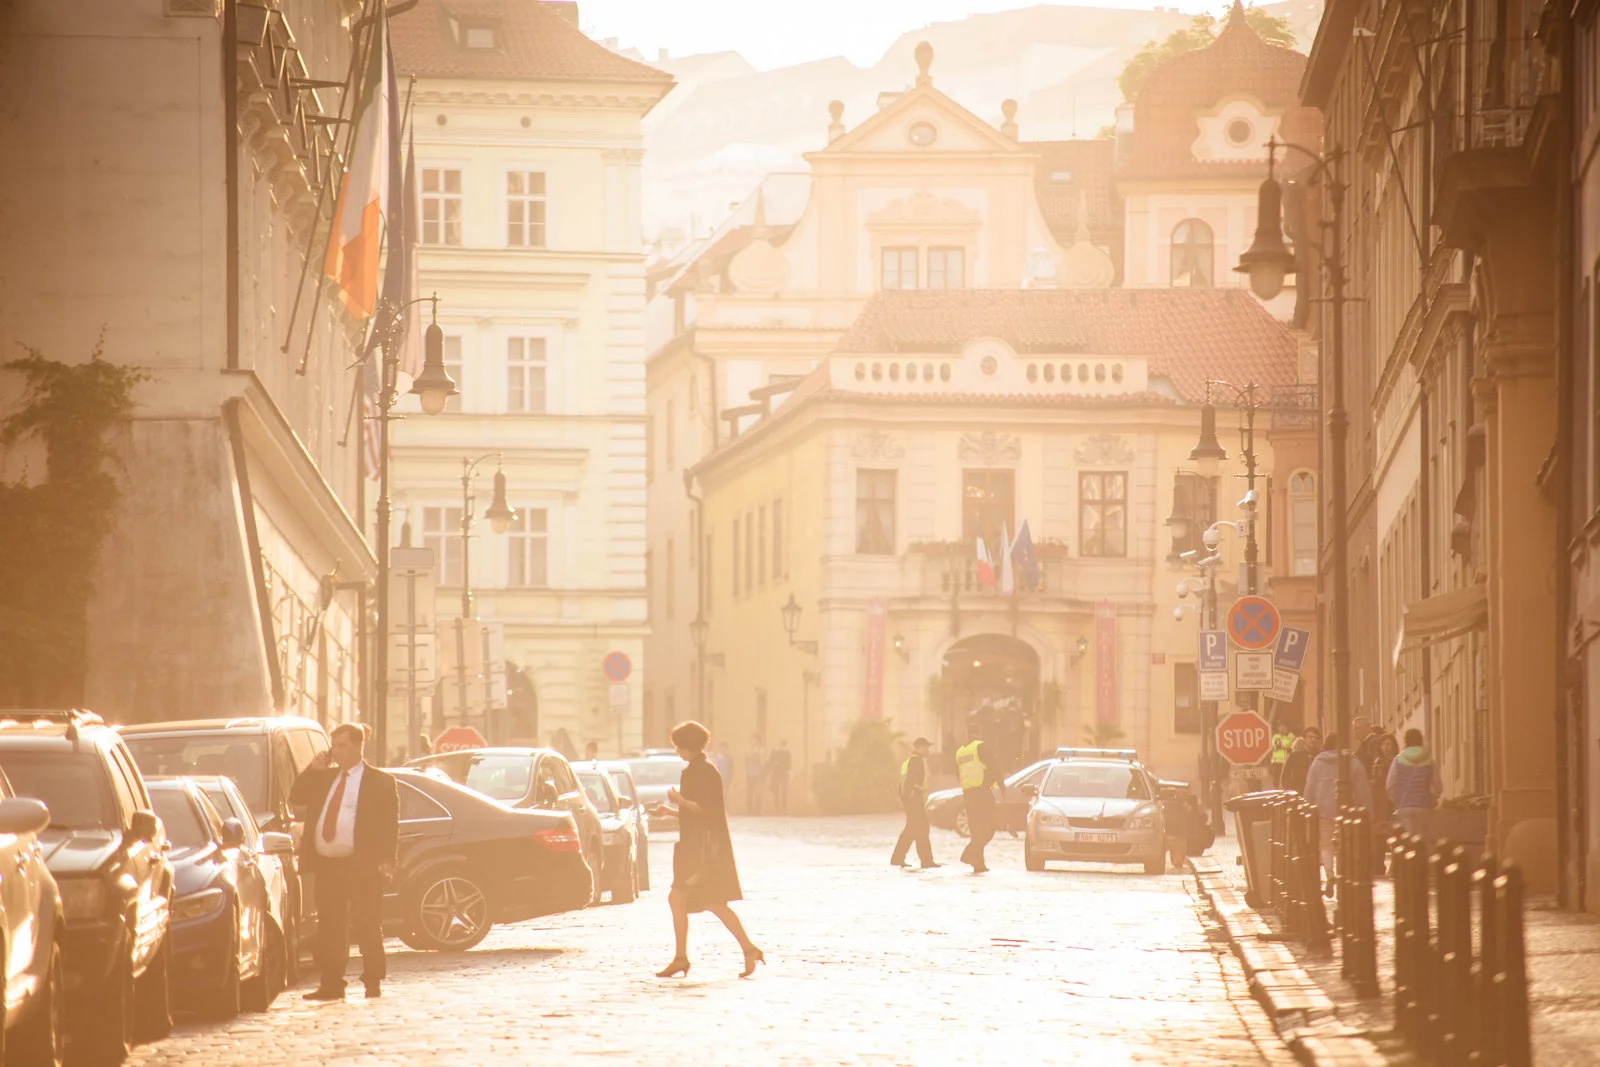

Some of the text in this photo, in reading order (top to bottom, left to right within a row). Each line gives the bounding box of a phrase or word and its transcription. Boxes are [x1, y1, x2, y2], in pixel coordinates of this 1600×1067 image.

[1206, 634, 1216, 656] P
[1284, 631, 1299, 653] P
[1223, 728, 1265, 749] STOP
